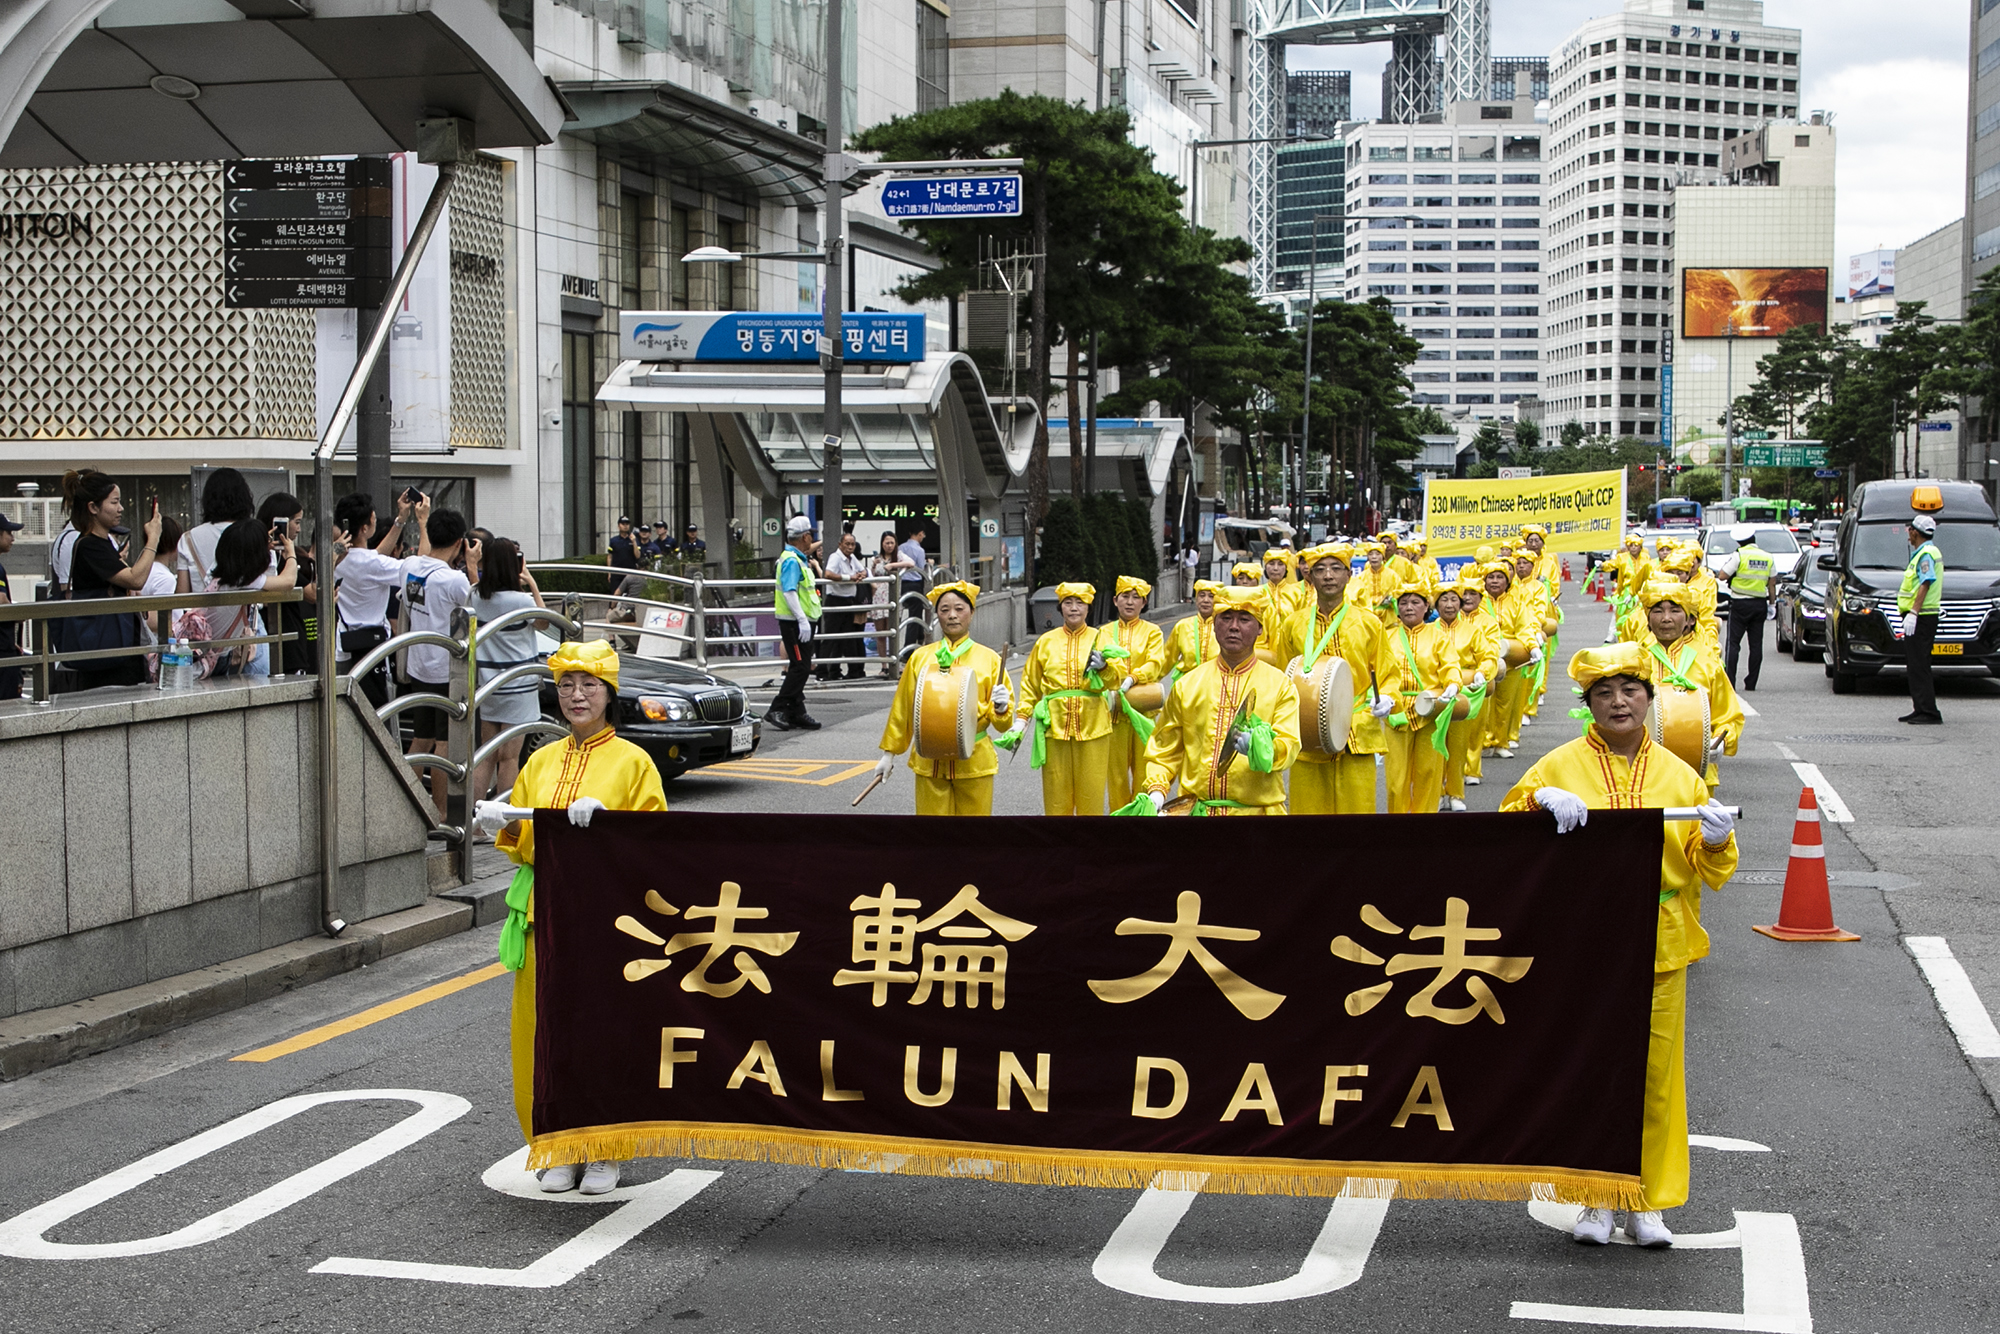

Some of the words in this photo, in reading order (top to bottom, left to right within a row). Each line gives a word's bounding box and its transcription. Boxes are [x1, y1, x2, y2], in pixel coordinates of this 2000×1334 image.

[1670, 24, 1740, 43] 경기빌딩
[273, 162, 346, 174] 크라운파크호텔
[927, 180, 1016, 199] 남대문로7길
[316, 192, 346, 203] 환구단
[998, 200, 1016, 213] 7-gil
[276, 224, 346, 236] 웨스틴조선호텔
[306, 254, 346, 266] 에비뉴엘
[296, 284, 346, 296] 롯데백화점
[561, 274, 600, 299] AVENUEL
[638, 334, 688, 351] 서울시설공단
[737, 328, 908, 353] 명동지하핑센터
[1431, 496, 1448, 513] 330
[1450, 495, 1479, 513] Million
[1481, 493, 1515, 512] Chinese
[1517, 492, 1547, 515] People
[1550, 491, 1572, 510] Have
[1574, 488, 1594, 513] Quit
[1596, 487, 1614, 506] CCP
[766, 521, 777, 532] 16
[983, 523, 995, 533] 16
[1432, 525, 1457, 539] 3억3천
[1459, 525, 1483, 539] 중국인
[1937, 645, 1960, 653] 1405
[615, 881, 1534, 1025] 法輪大法
[659, 1027, 1050, 1112] FALUN
[1132, 1056, 1454, 1132] DAFA
